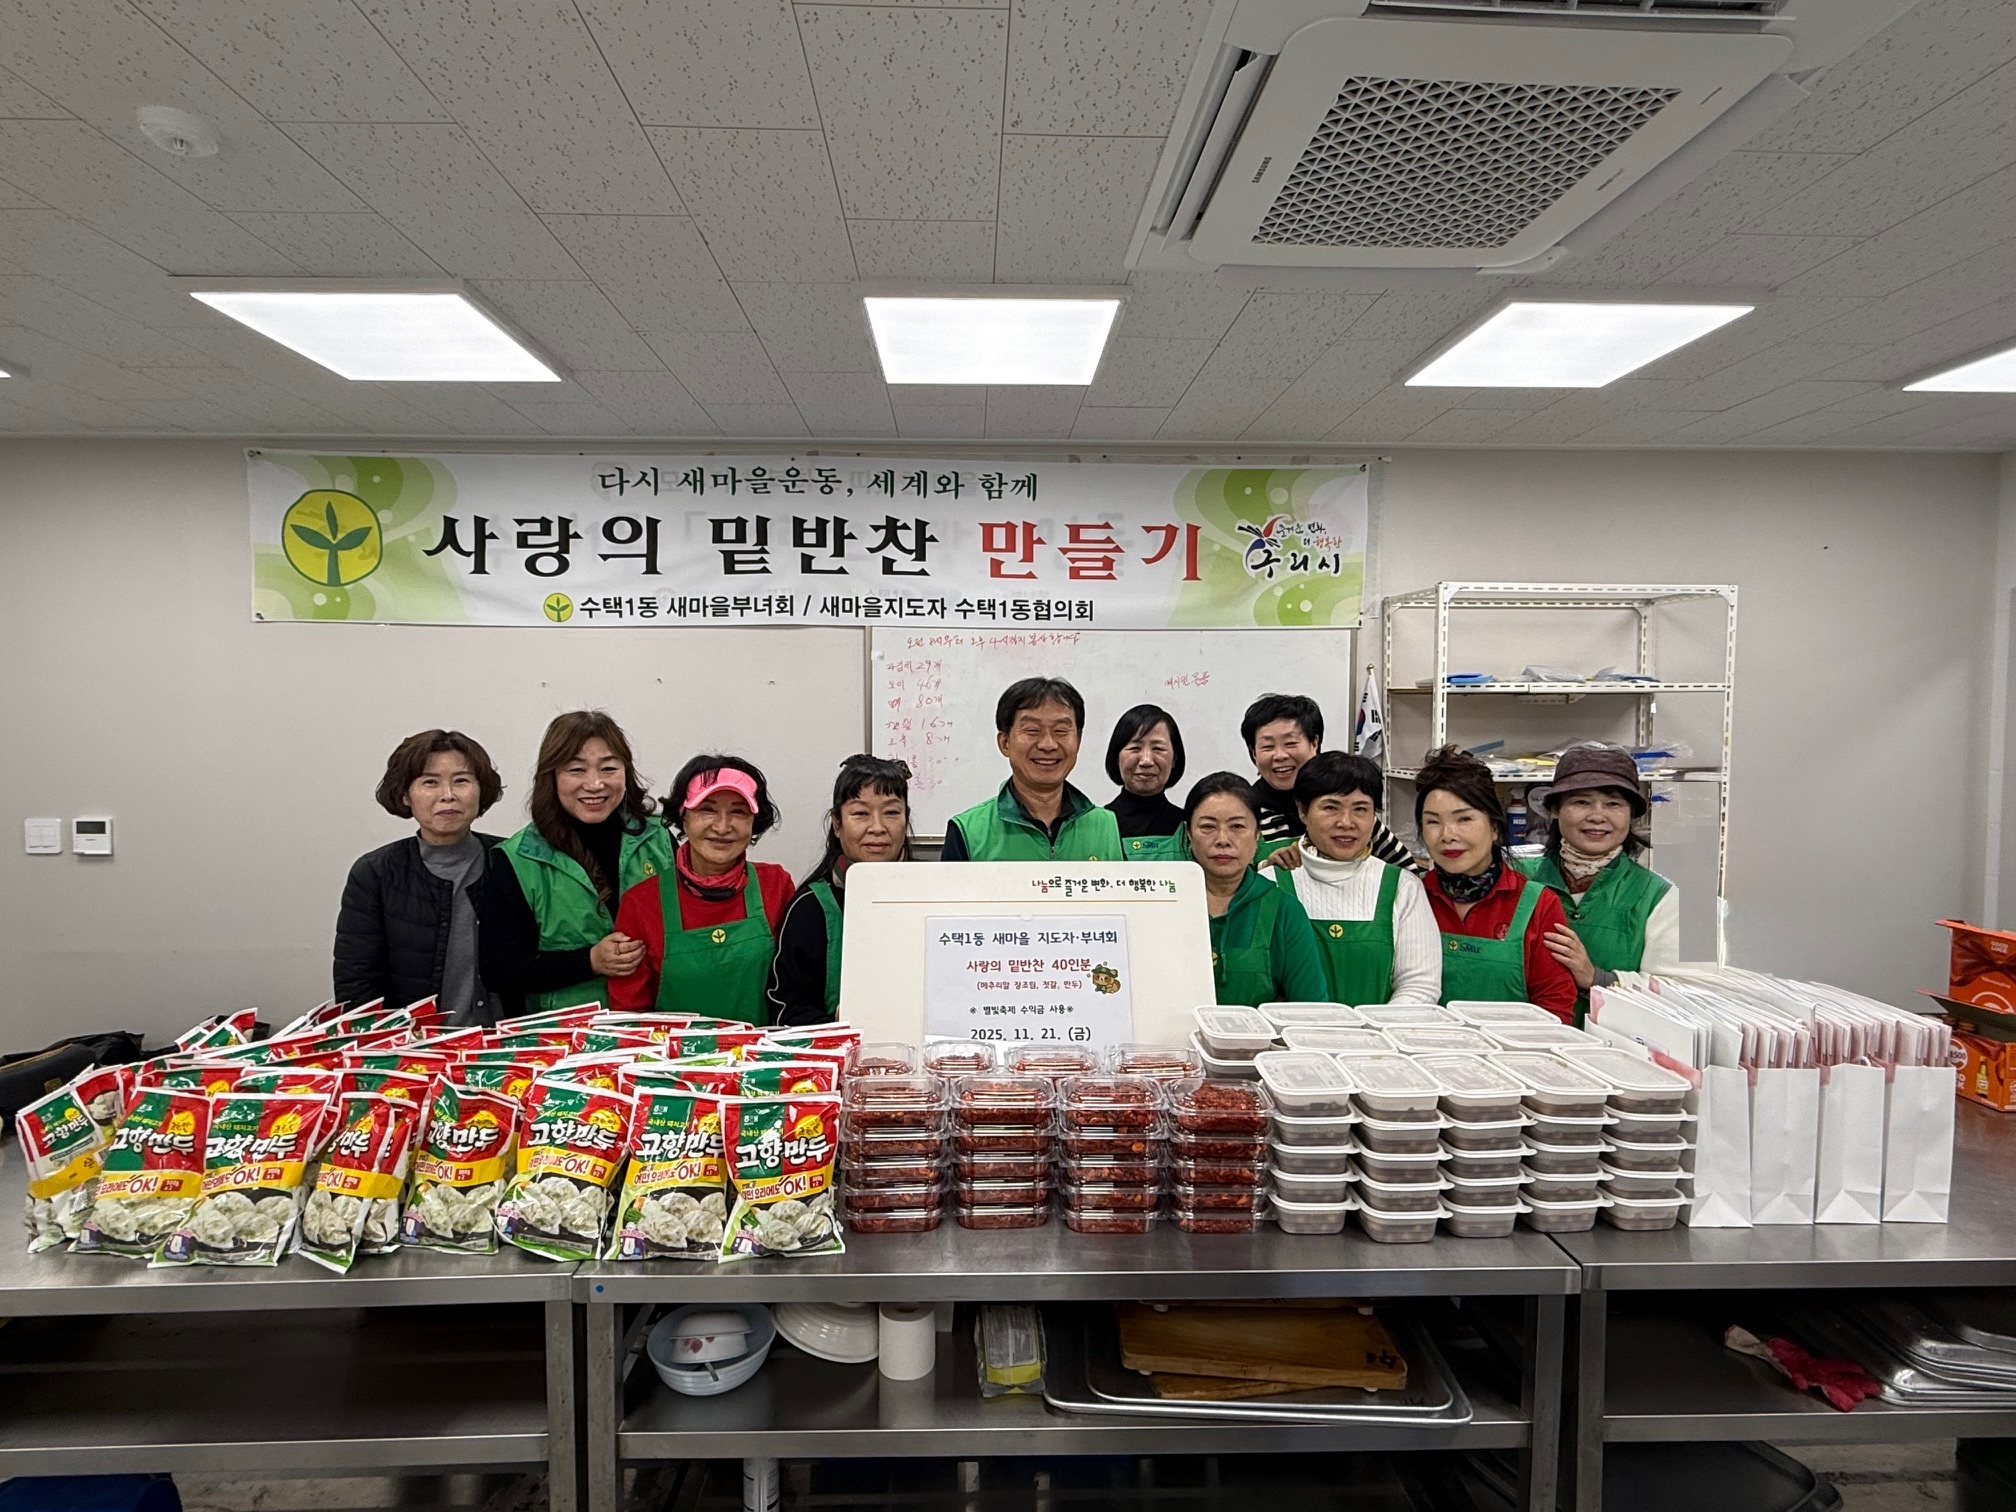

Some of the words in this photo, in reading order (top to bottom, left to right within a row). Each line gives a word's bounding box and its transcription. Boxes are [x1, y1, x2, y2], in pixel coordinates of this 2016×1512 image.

[598, 466, 659, 496] 다시
[676, 466, 854, 497] 새마을운동,
[867, 469, 965, 500] 세계와
[978, 472, 1038, 501] 함께
[422, 514, 663, 577] 사랑의
[708, 514, 940, 576] 밑반찬
[978, 520, 1203, 581] 만들기
[1313, 536, 1343, 552] 행복한
[1250, 549, 1341, 579] 구리시
[579, 596, 659, 619] 수택1동
[666, 595, 794, 618] 새마을부녀회
[819, 595, 947, 619] 새마을지도자
[954, 598, 1095, 621] 수택1동협의회
[888, 680, 906, 691] 오이
[1032, 876, 1062, 893] 나눔으로
[1064, 879, 1088, 897] 즐거운
[1128, 878, 1156, 893] 행복한
[1159, 879, 1176, 893] 나눔
[938, 932, 985, 946] 수택1동
[992, 932, 1030, 946] 새마을
[966, 960, 1001, 973] 사랑의
[1008, 958, 1044, 973] 밑반찬
[1051, 958, 1092, 972] 40인분
[976, 981, 1010, 990] (메추리알
[1014, 980, 1039, 990] 장조림,
[1063, 980, 1083, 990] 만두)
[983, 1005, 1016, 1015] 별빛축제
[1020, 1004, 1045, 1014] 수익금
[970, 1028, 1007, 1041] 2025.
[1014, 1028, 1034, 1041] 11.
[1041, 1027, 1061, 1040] 21.
[1068, 1026, 1091, 1041] (금)
[42, 1114, 89, 1149] 고향만두
[108, 1125, 195, 1156] 고향만두
[527, 1118, 619, 1151] 고향만두
[206, 1132, 299, 1160] 고향만두
[327, 1129, 371, 1158] 만두
[635, 1129, 724, 1159] 고향만두
[735, 1133, 831, 1169] 고향만두
[233, 1166, 261, 1185] OK!
[437, 1162, 453, 1180] OK!
[564, 1156, 591, 1175] OK!
[678, 1161, 702, 1181] OK!
[130, 1174, 160, 1194] OK!
[755, 1183, 780, 1199] 요리에도
[784, 1175, 807, 1196] OK!
